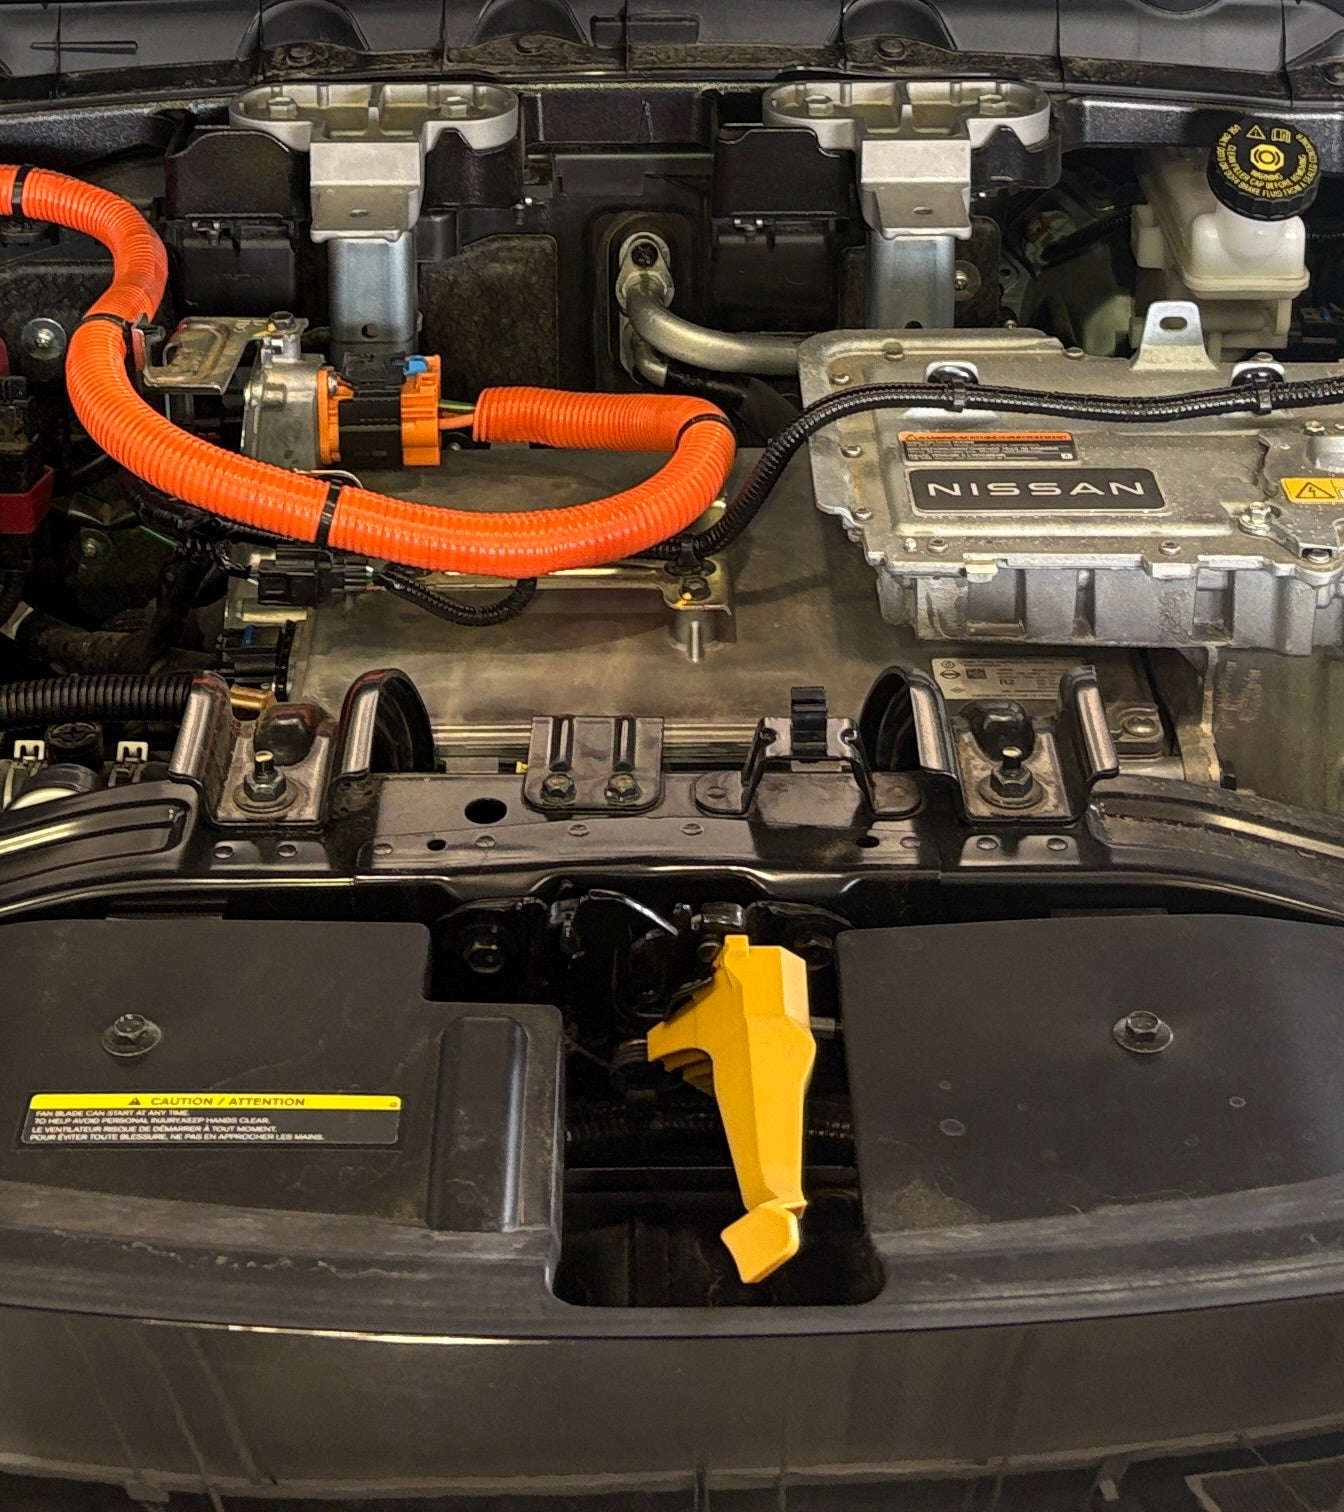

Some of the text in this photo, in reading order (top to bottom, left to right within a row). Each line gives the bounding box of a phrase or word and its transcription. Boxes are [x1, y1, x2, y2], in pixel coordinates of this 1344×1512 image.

[1249, 178, 1265, 189] CAP
[927, 481, 1145, 497] NISSAN
[150, 1097, 306, 1106] CAUTION / ATTENTION
[32, 1125, 43, 1133] LE
[44, 1125, 102, 1133] VENTILATEUR
[103, 1125, 137, 1133] RISQUE
[138, 1125, 151, 1133] DE
[152, 1125, 203, 1133] DÉMARRER
[212, 1125, 235, 1133] TOUT
[236, 1125, 277, 1133] MOMENT.
[30, 1133, 56, 1141] POUR
[57, 1133, 88, 1141] ÉVITER
[90, 1133, 118, 1141] TOUTE
[170, 1133, 184, 1141] NE
[184, 1133, 203, 1141] PAS
[204, 1133, 217, 1141] EN
[218, 1133, 274, 1141] APPROCHER
[275, 1133, 293, 1141] LES
